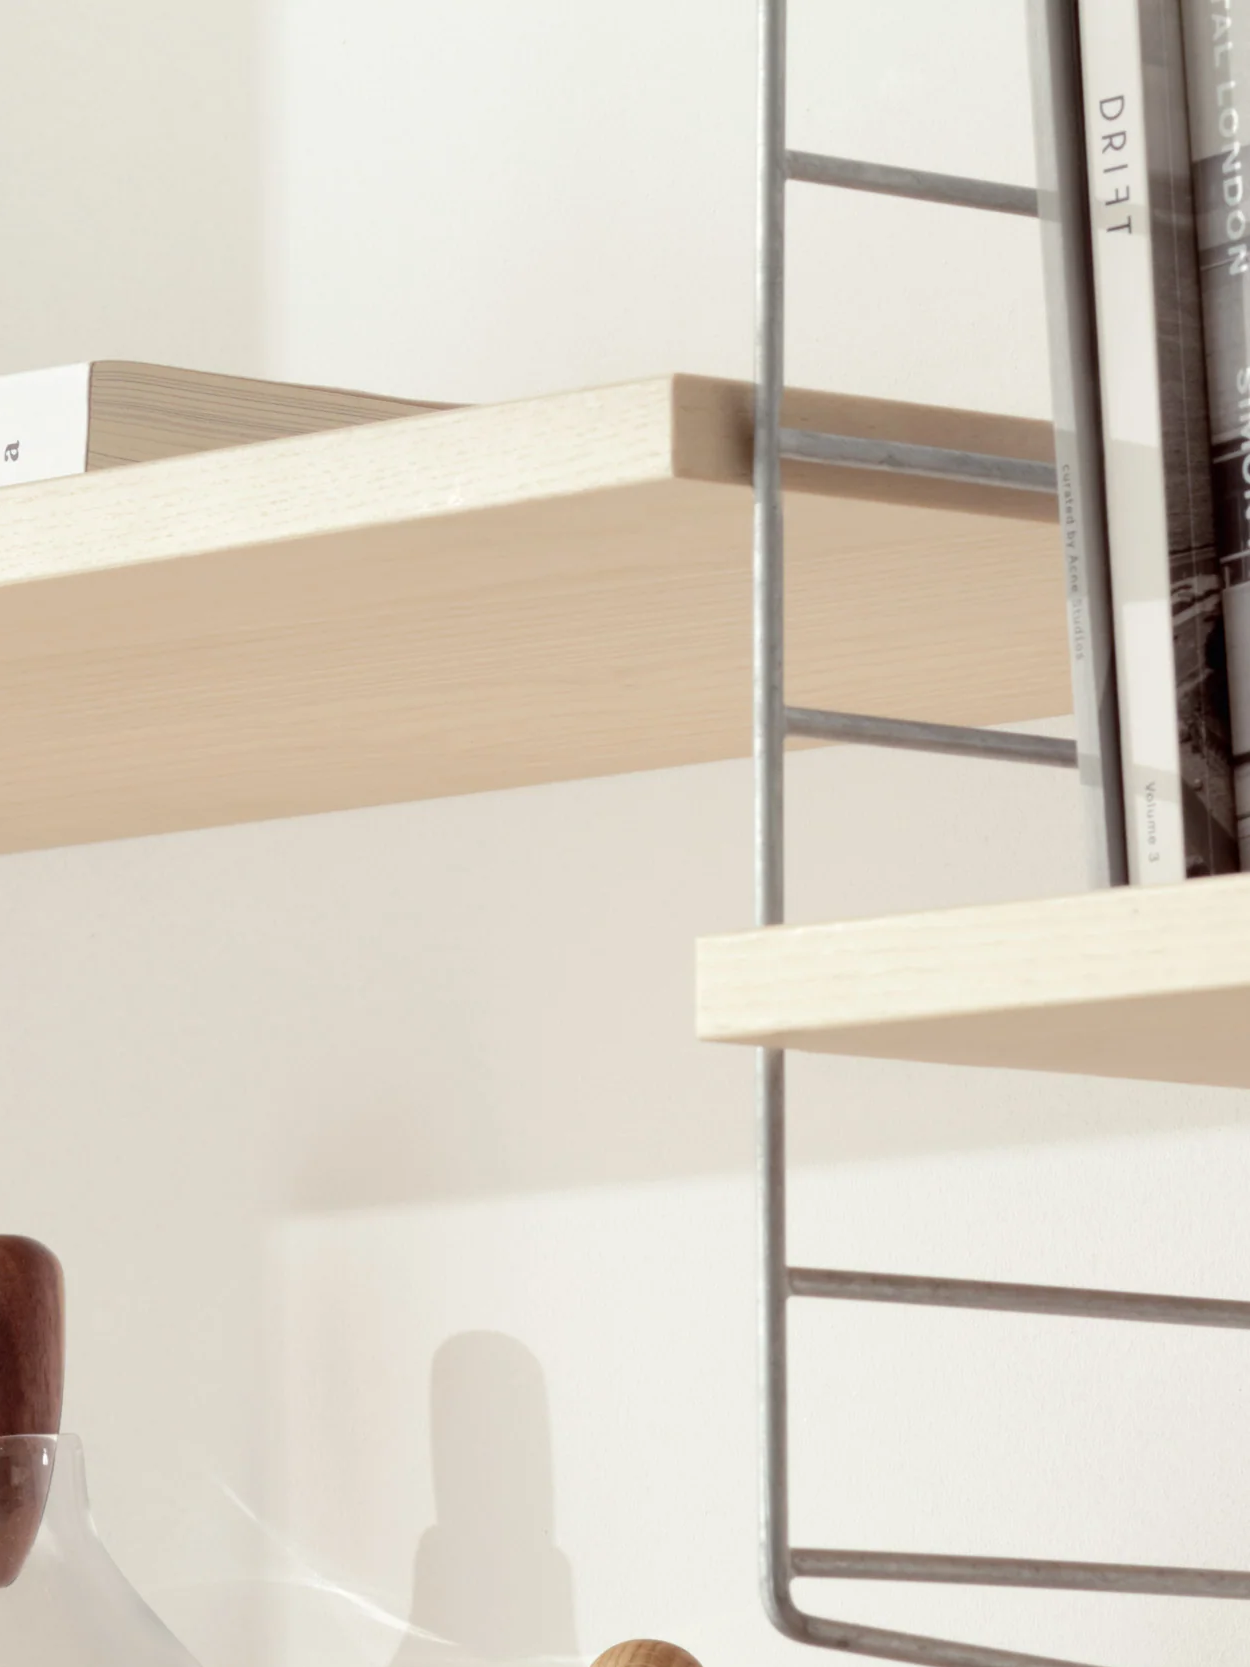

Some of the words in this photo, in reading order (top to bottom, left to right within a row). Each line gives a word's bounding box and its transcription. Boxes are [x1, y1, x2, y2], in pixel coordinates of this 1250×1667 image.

[1217, 81, 1248, 275] LONDON
[1062, 464, 1076, 525] curated
[1066, 530, 1077, 549] by
[1068, 554, 1079, 592] Acne
[1072, 598, 1086, 661] Studios
[1145, 781, 1157, 845] Volume
[1148, 852, 1160, 863] 3
